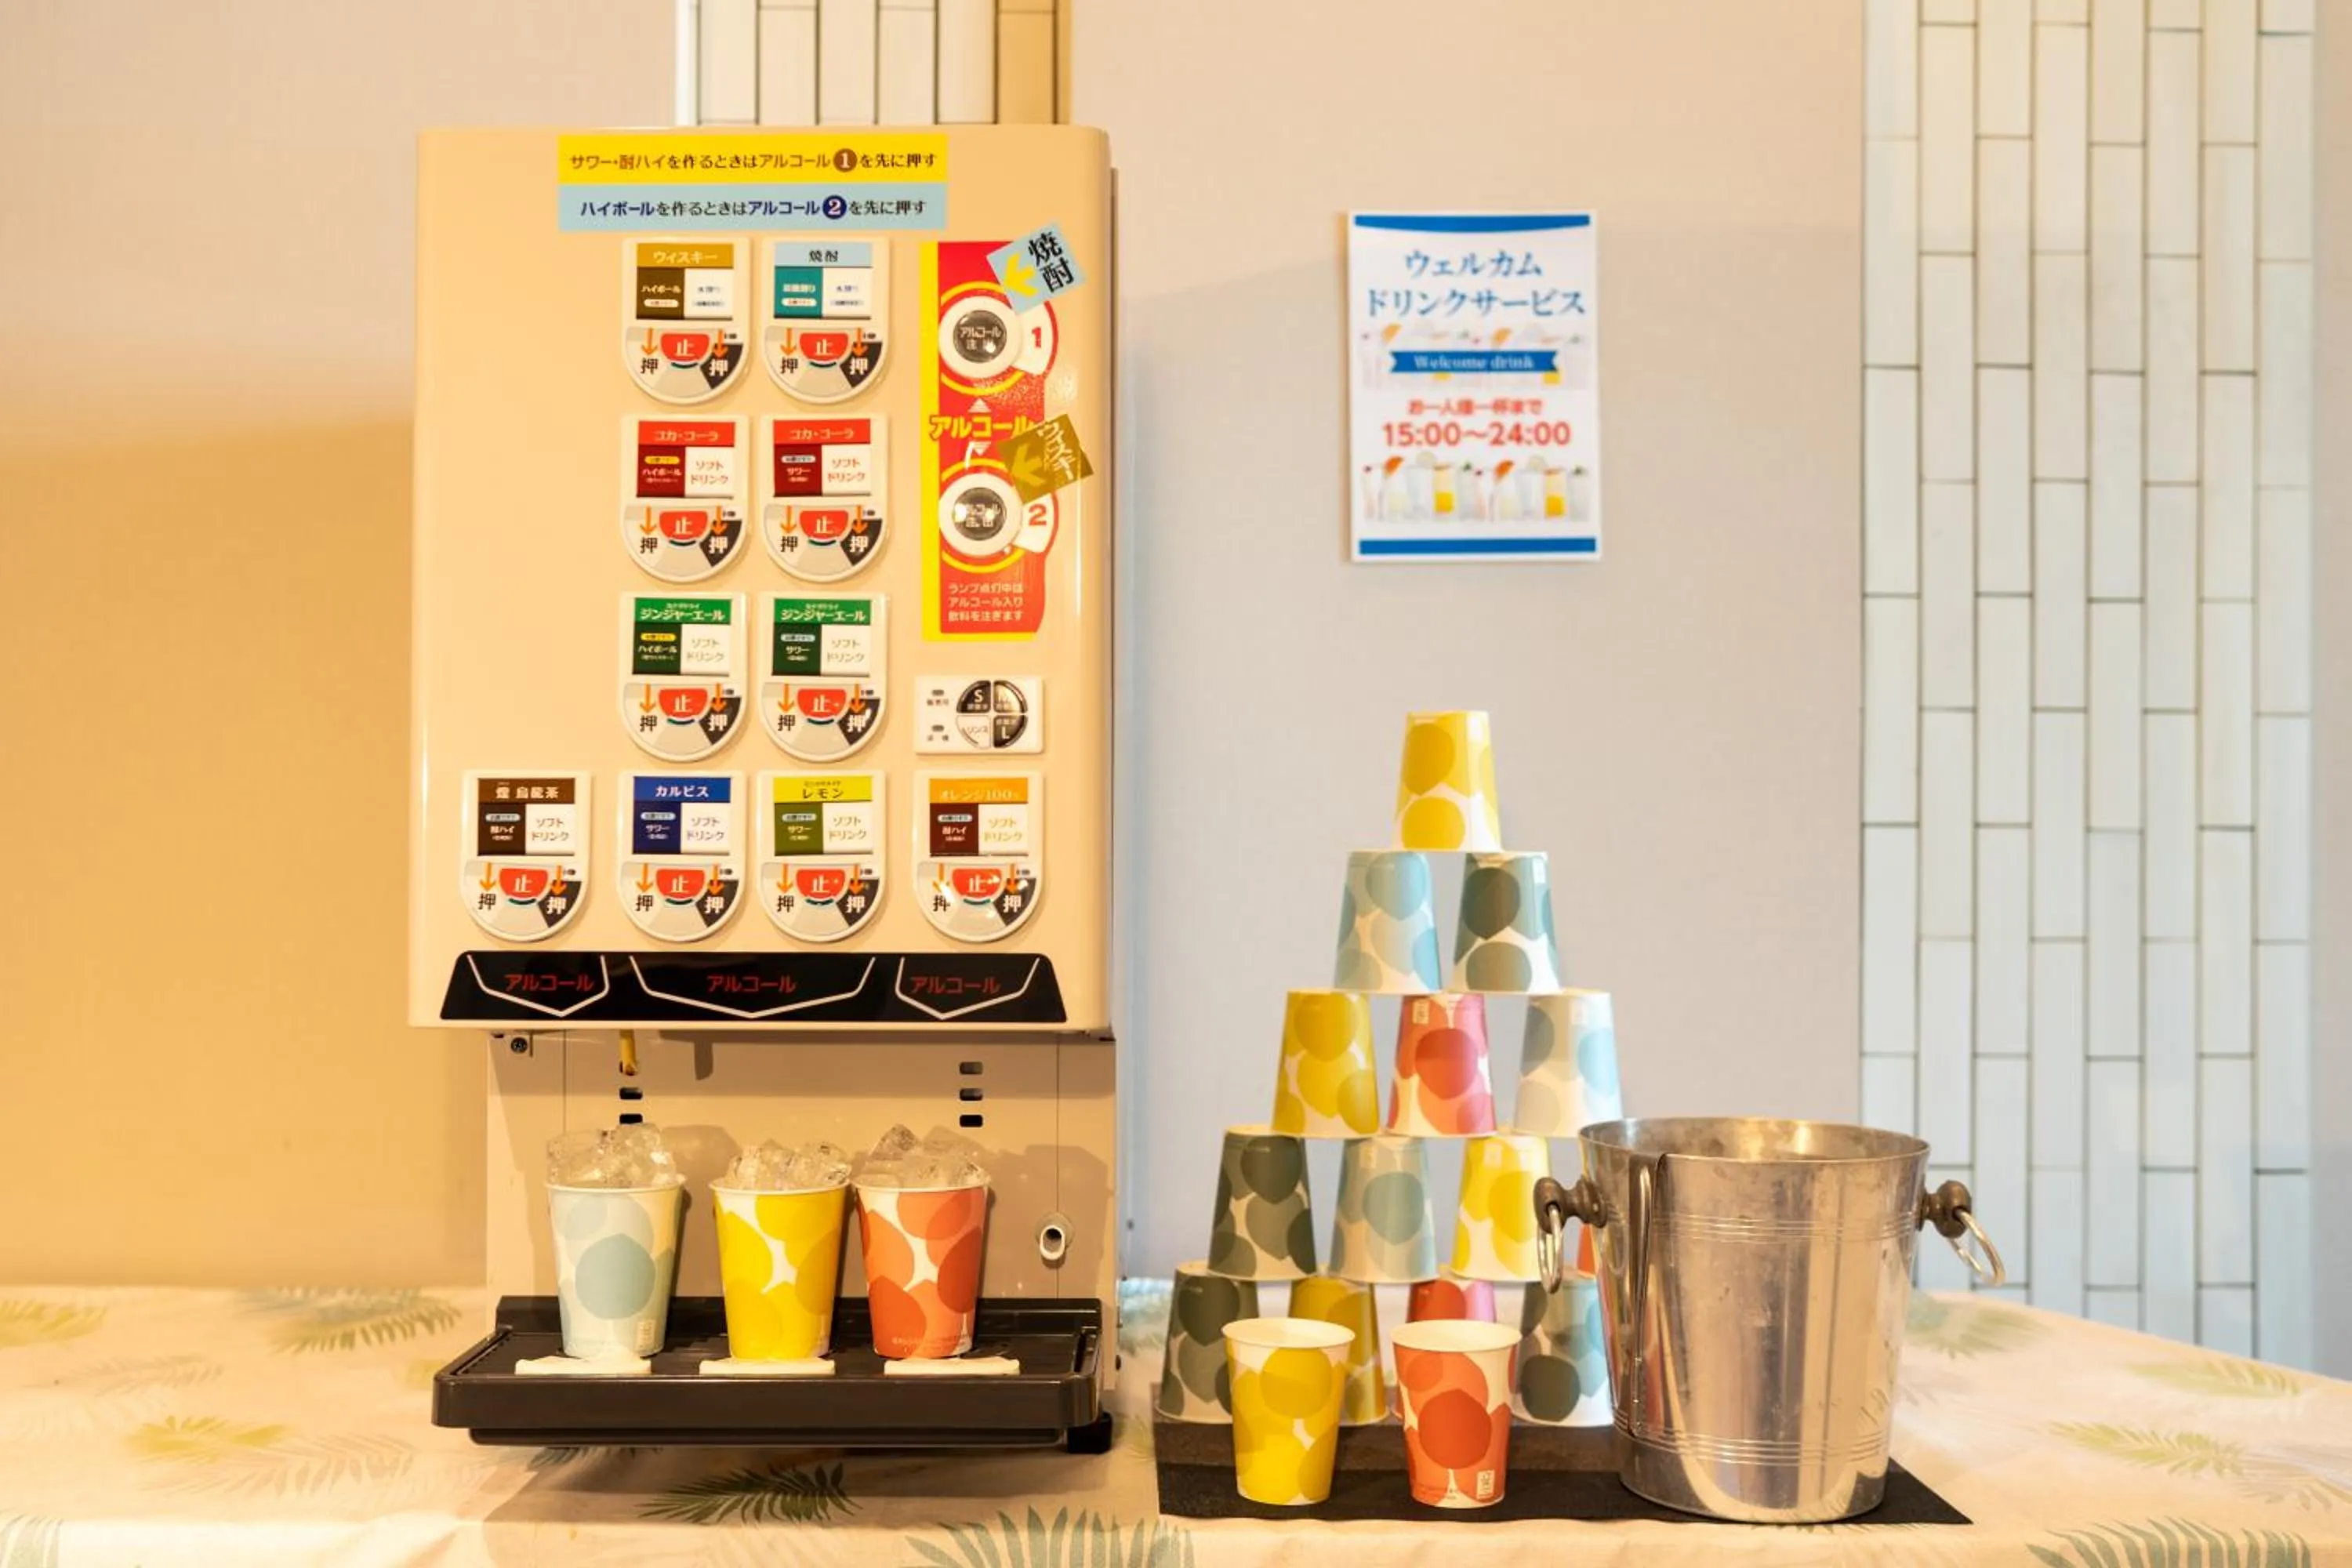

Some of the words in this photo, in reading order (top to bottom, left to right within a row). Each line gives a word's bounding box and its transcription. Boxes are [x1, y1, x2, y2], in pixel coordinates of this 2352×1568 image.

[1028, 231, 1074, 293] 焼酎
[1406, 249, 1542, 278] ウェルカム
[1369, 289, 1585, 316] ドリンクサービス
[960, 326, 1001, 338] アルコール
[1031, 326, 1042, 348] 1
[675, 338, 695, 357] 止
[815, 338, 833, 356] 止
[641, 358, 659, 374] 押
[709, 358, 728, 377] 押
[780, 358, 798, 374] 押
[850, 357, 868, 376] 押
[1414, 355, 1486, 369] Welcome
[1490, 355, 1534, 369] drink
[1029, 503, 1047, 527] 2
[673, 517, 693, 535] 止
[815, 515, 833, 535] 止
[640, 536, 658, 554] 押
[709, 535, 728, 554] 押
[780, 535, 798, 553] 押
[850, 535, 869, 553] 押
[640, 608, 725, 621] ジンジャーエール
[781, 609, 866, 622] ジンジャーエール
[673, 694, 693, 713] 止
[812, 694, 832, 713] 止
[974, 689, 984, 702] S
[640, 714, 658, 731] 押
[708, 713, 728, 731] 押
[777, 714, 795, 731] 押
[848, 714, 866, 732] 押
[1001, 726, 1010, 739] L
[803, 788, 844, 799] レモン
[513, 874, 533, 893] 止
[671, 875, 690, 894] 止
[811, 875, 829, 893] 止
[967, 874, 986, 893] 止
[478, 892, 496, 910] 押
[546, 896, 567, 915] 押
[635, 895, 654, 912] 押
[705, 896, 724, 914] 押
[777, 895, 794, 913] 押
[847, 895, 865, 913] 押
[1004, 895, 1022, 913] 押
[504, 975, 594, 992] アルコール
[707, 975, 797, 993] アルコール
[909, 976, 1001, 994] アルコール
